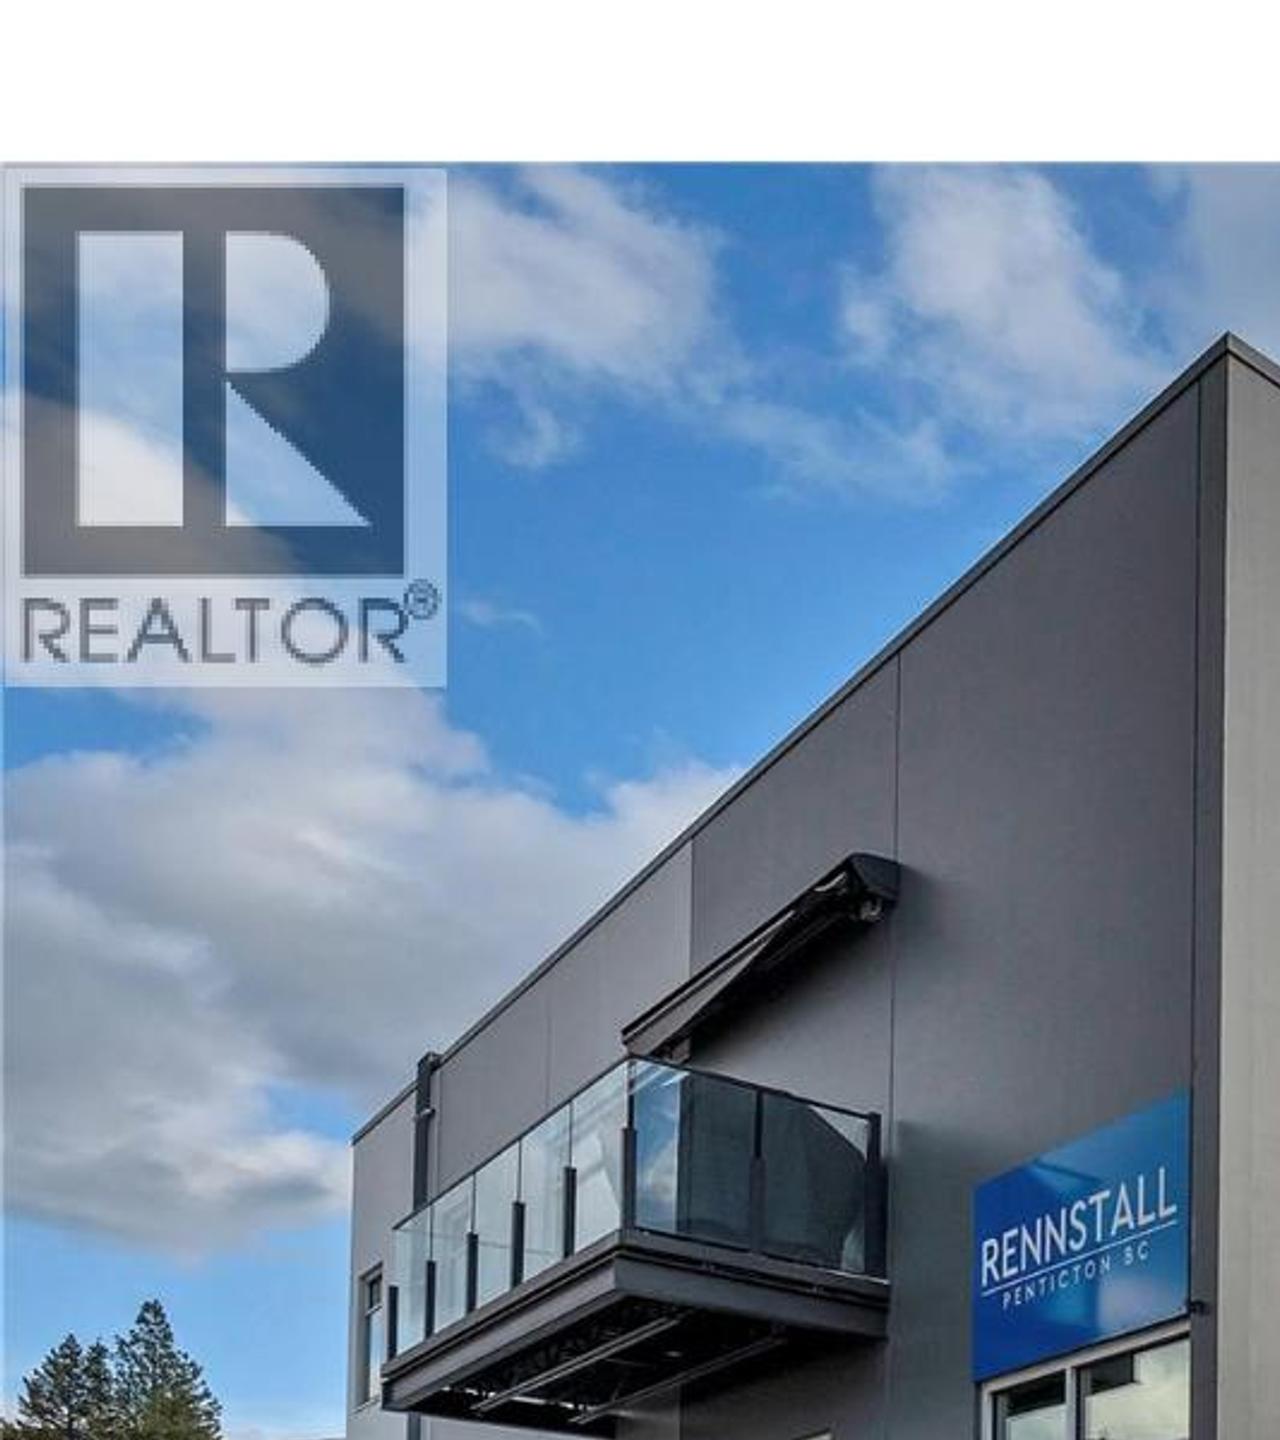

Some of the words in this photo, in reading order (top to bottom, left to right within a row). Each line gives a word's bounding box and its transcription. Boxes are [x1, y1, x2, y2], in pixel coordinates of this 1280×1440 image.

[981, 1166, 1178, 1288] RENNSTALL
[1002, 1257, 1111, 1311] PENTICTON
[1123, 1240, 1151, 1266] BC
